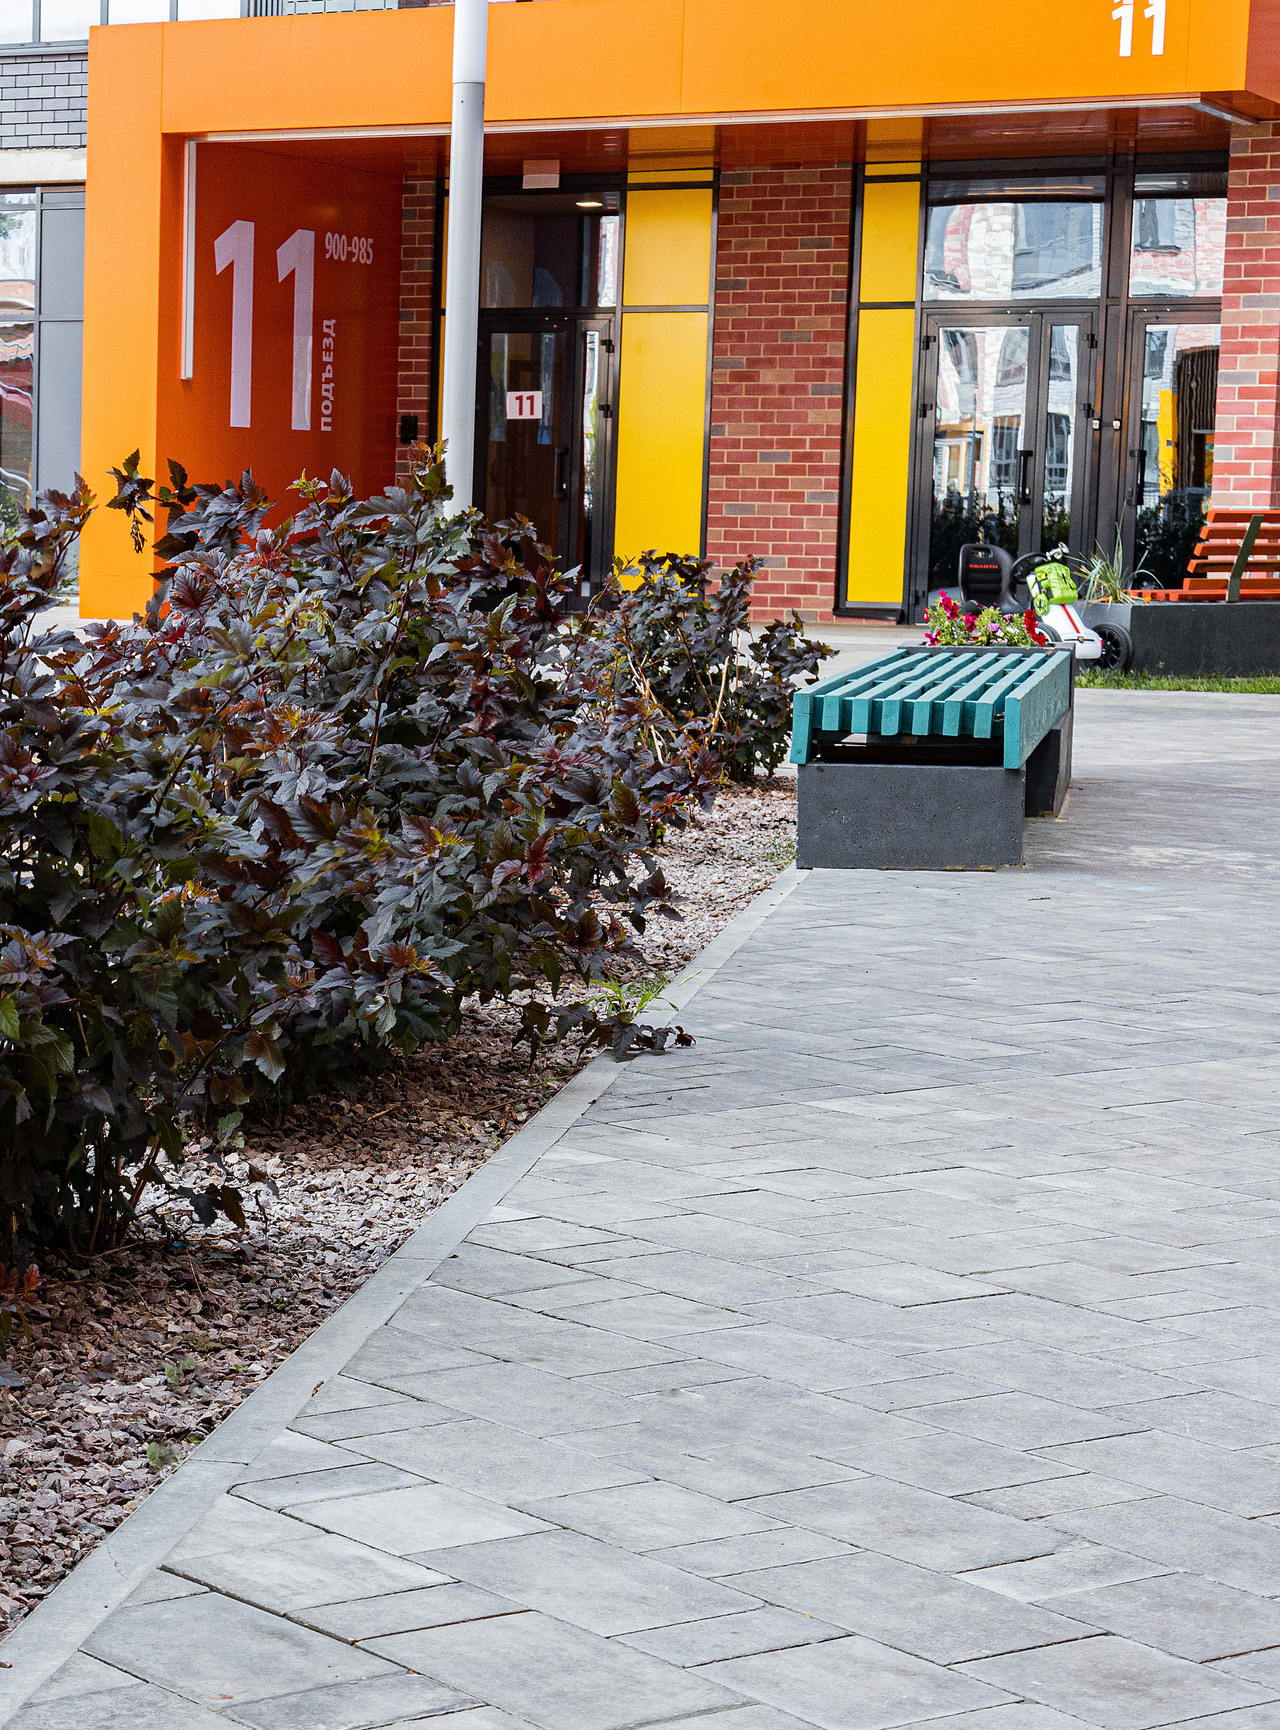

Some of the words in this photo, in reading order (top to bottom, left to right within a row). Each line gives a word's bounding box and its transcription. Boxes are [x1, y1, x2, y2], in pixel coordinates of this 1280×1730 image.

[1111, 3, 1167, 57] 11
[325, 231, 374, 264] 900-985
[213, 219, 315, 431] 11
[321, 319, 336, 432] ПОДЪЕЗД
[515, 394, 535, 416] 11
